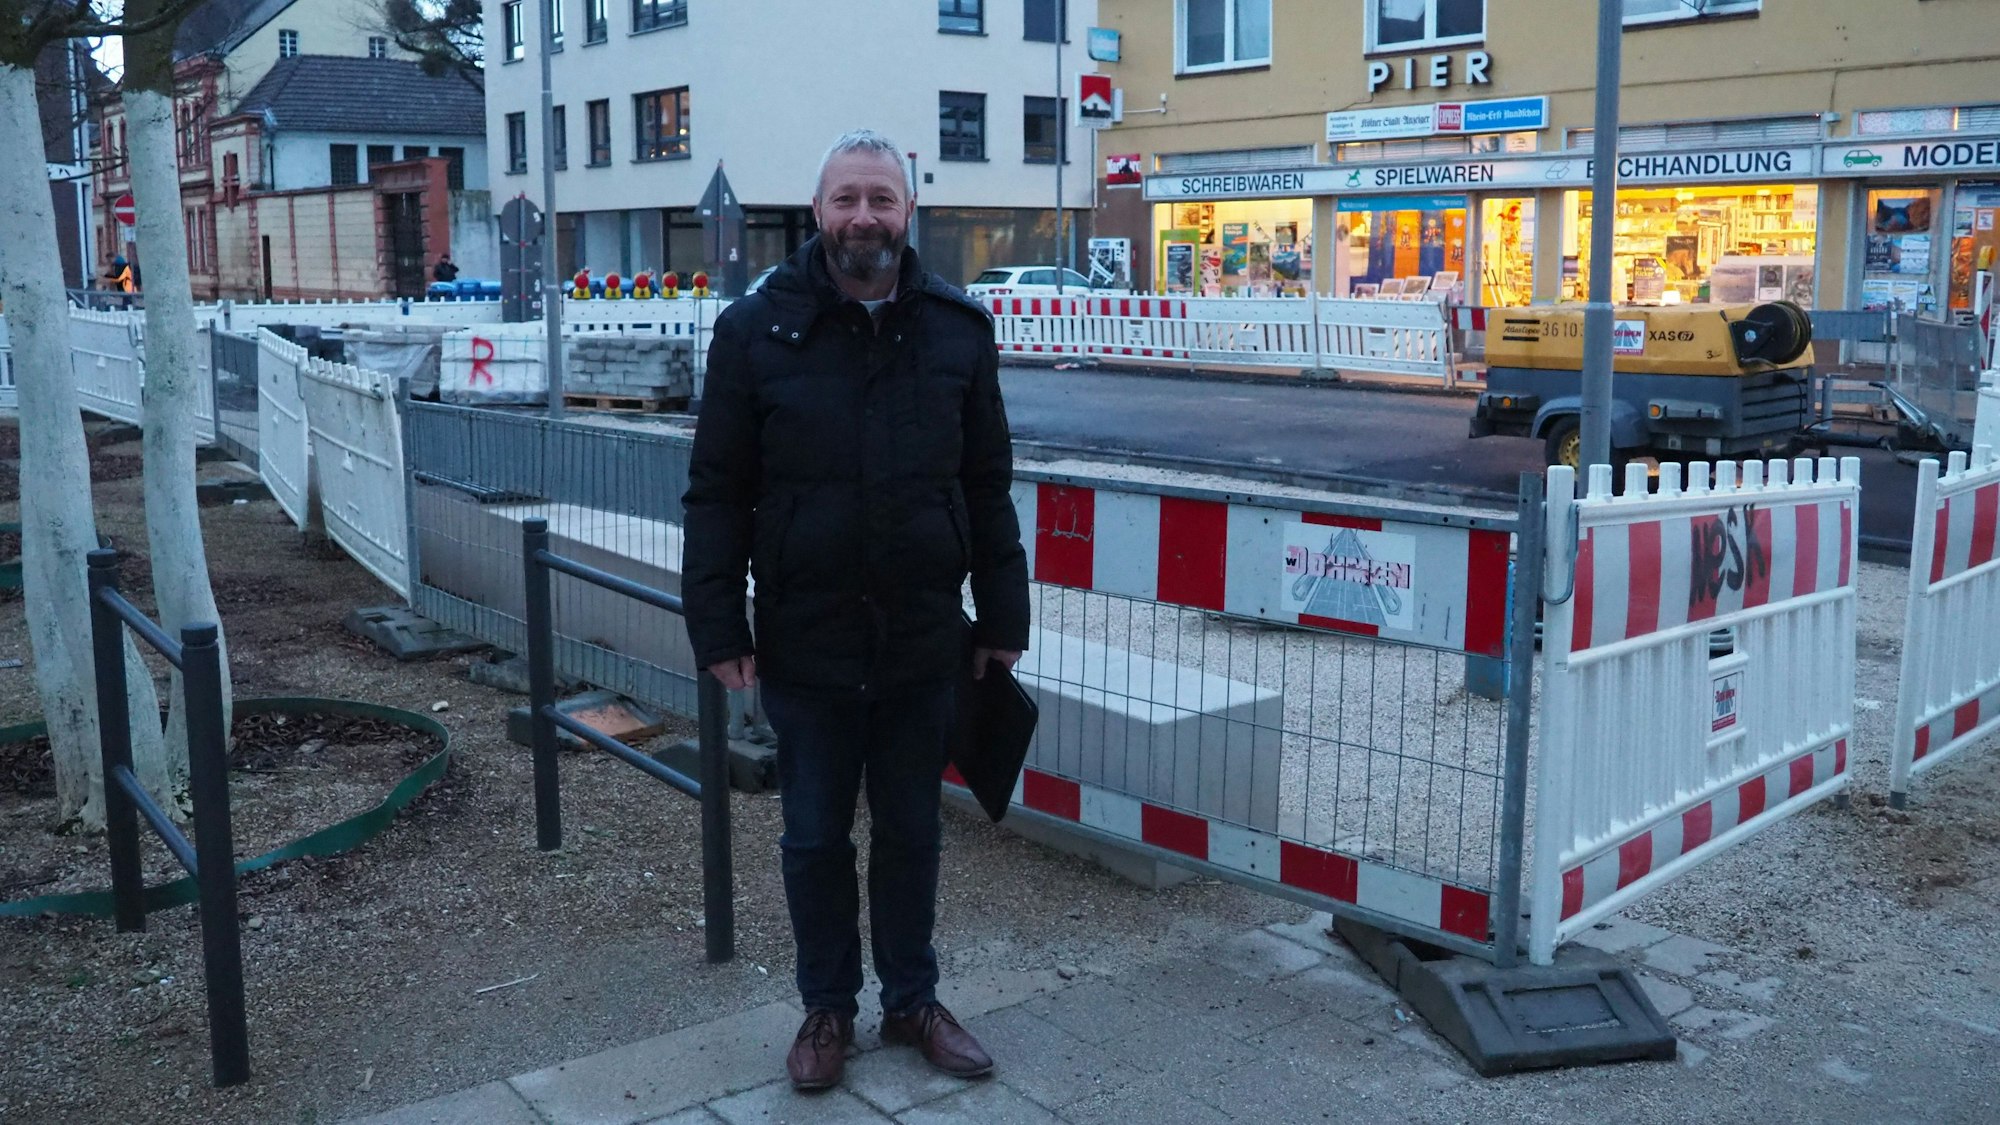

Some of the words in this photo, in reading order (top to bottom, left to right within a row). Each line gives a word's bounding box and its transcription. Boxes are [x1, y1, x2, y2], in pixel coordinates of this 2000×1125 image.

[1369, 51, 1490, 92] PIER
[1440, 109, 1461, 124] EXPRESS
[1587, 151, 1792, 178] BCHHANDLUNG
[1904, 142, 2000, 167] MODE
[1182, 173, 1304, 194] SCHREIBWAREN
[1375, 164, 1494, 186] SPIELWAREN
[1649, 331, 1676, 341] XAS
[468, 336, 495, 386] R
[1286, 545, 1410, 589] DOHMEN
